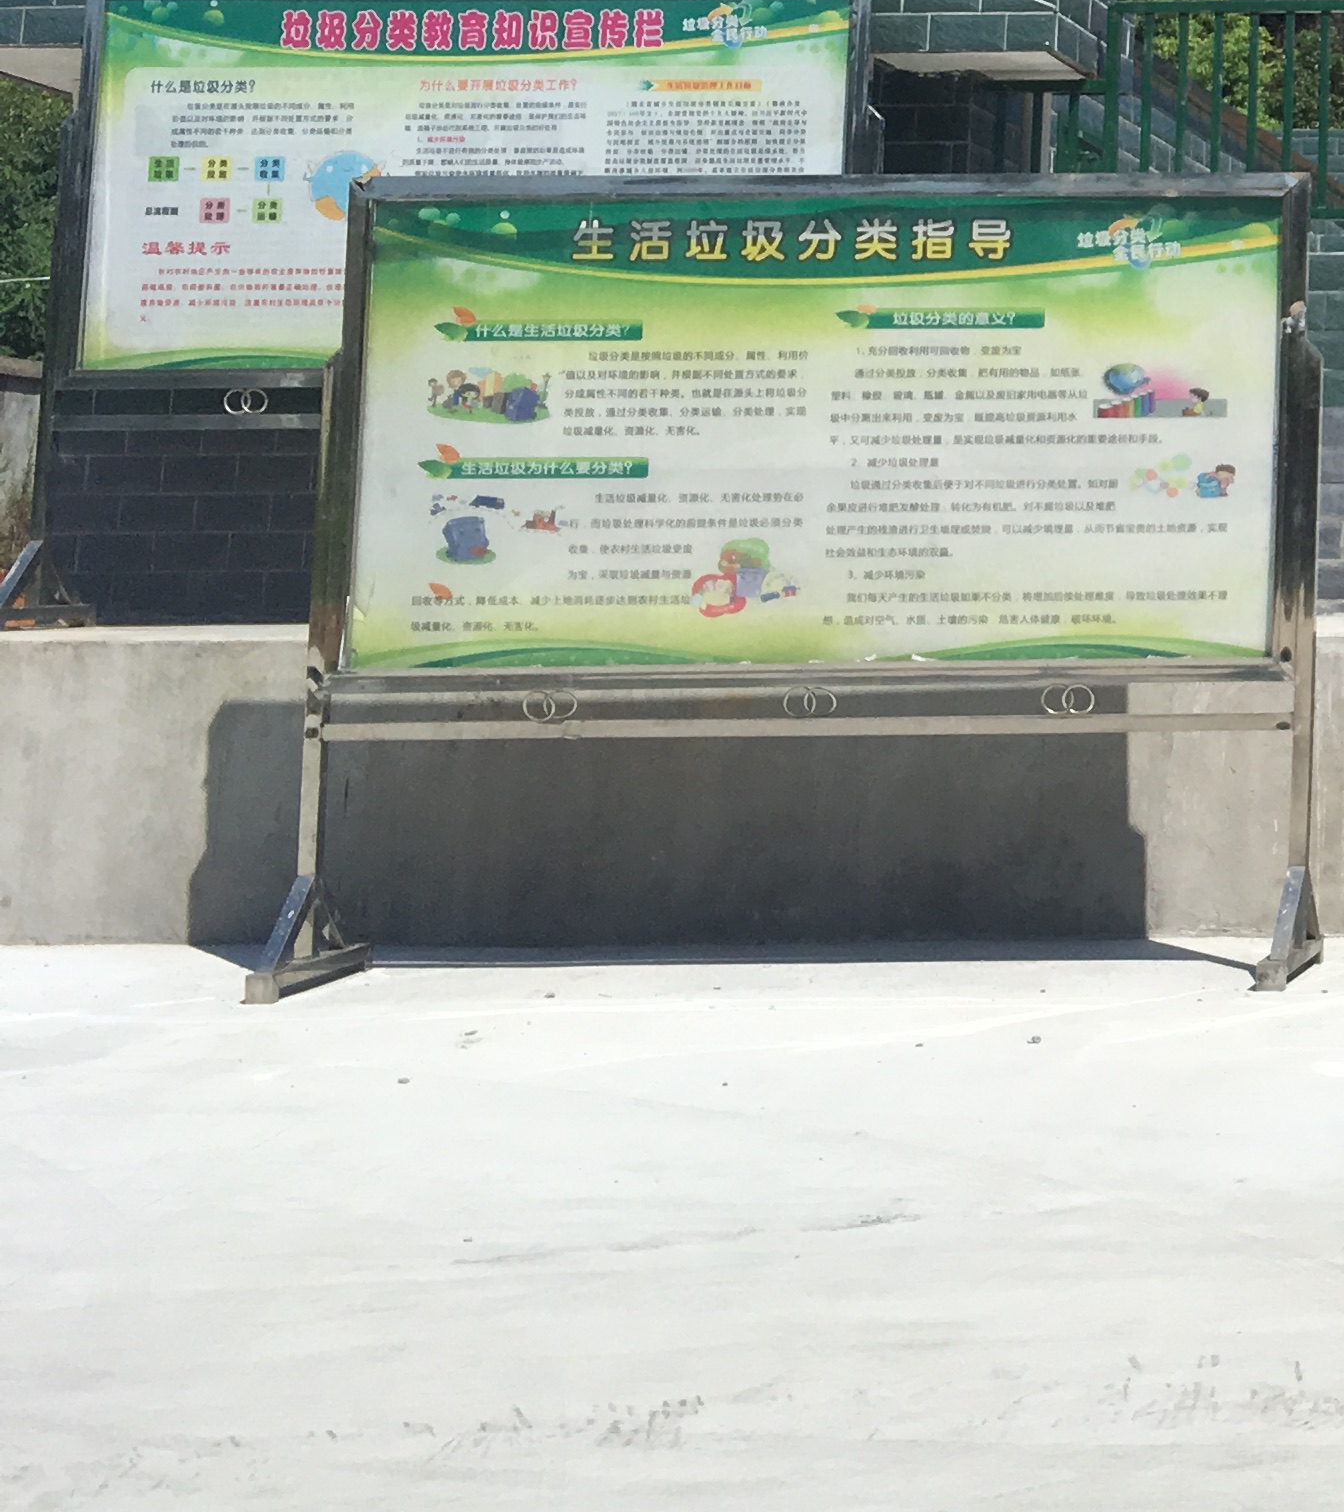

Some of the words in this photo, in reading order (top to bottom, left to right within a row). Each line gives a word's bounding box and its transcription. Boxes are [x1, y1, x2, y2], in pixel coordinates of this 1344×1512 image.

[280, 8, 664, 51] 垃圾分类教育知识宣传栏
[141, 241, 231, 255] 温馨提示
[571, 218, 1013, 262] 生活垃圾分类指导
[1076, 227, 1147, 249] 垃圾分类
[1112, 241, 1181, 262] 全民行动
